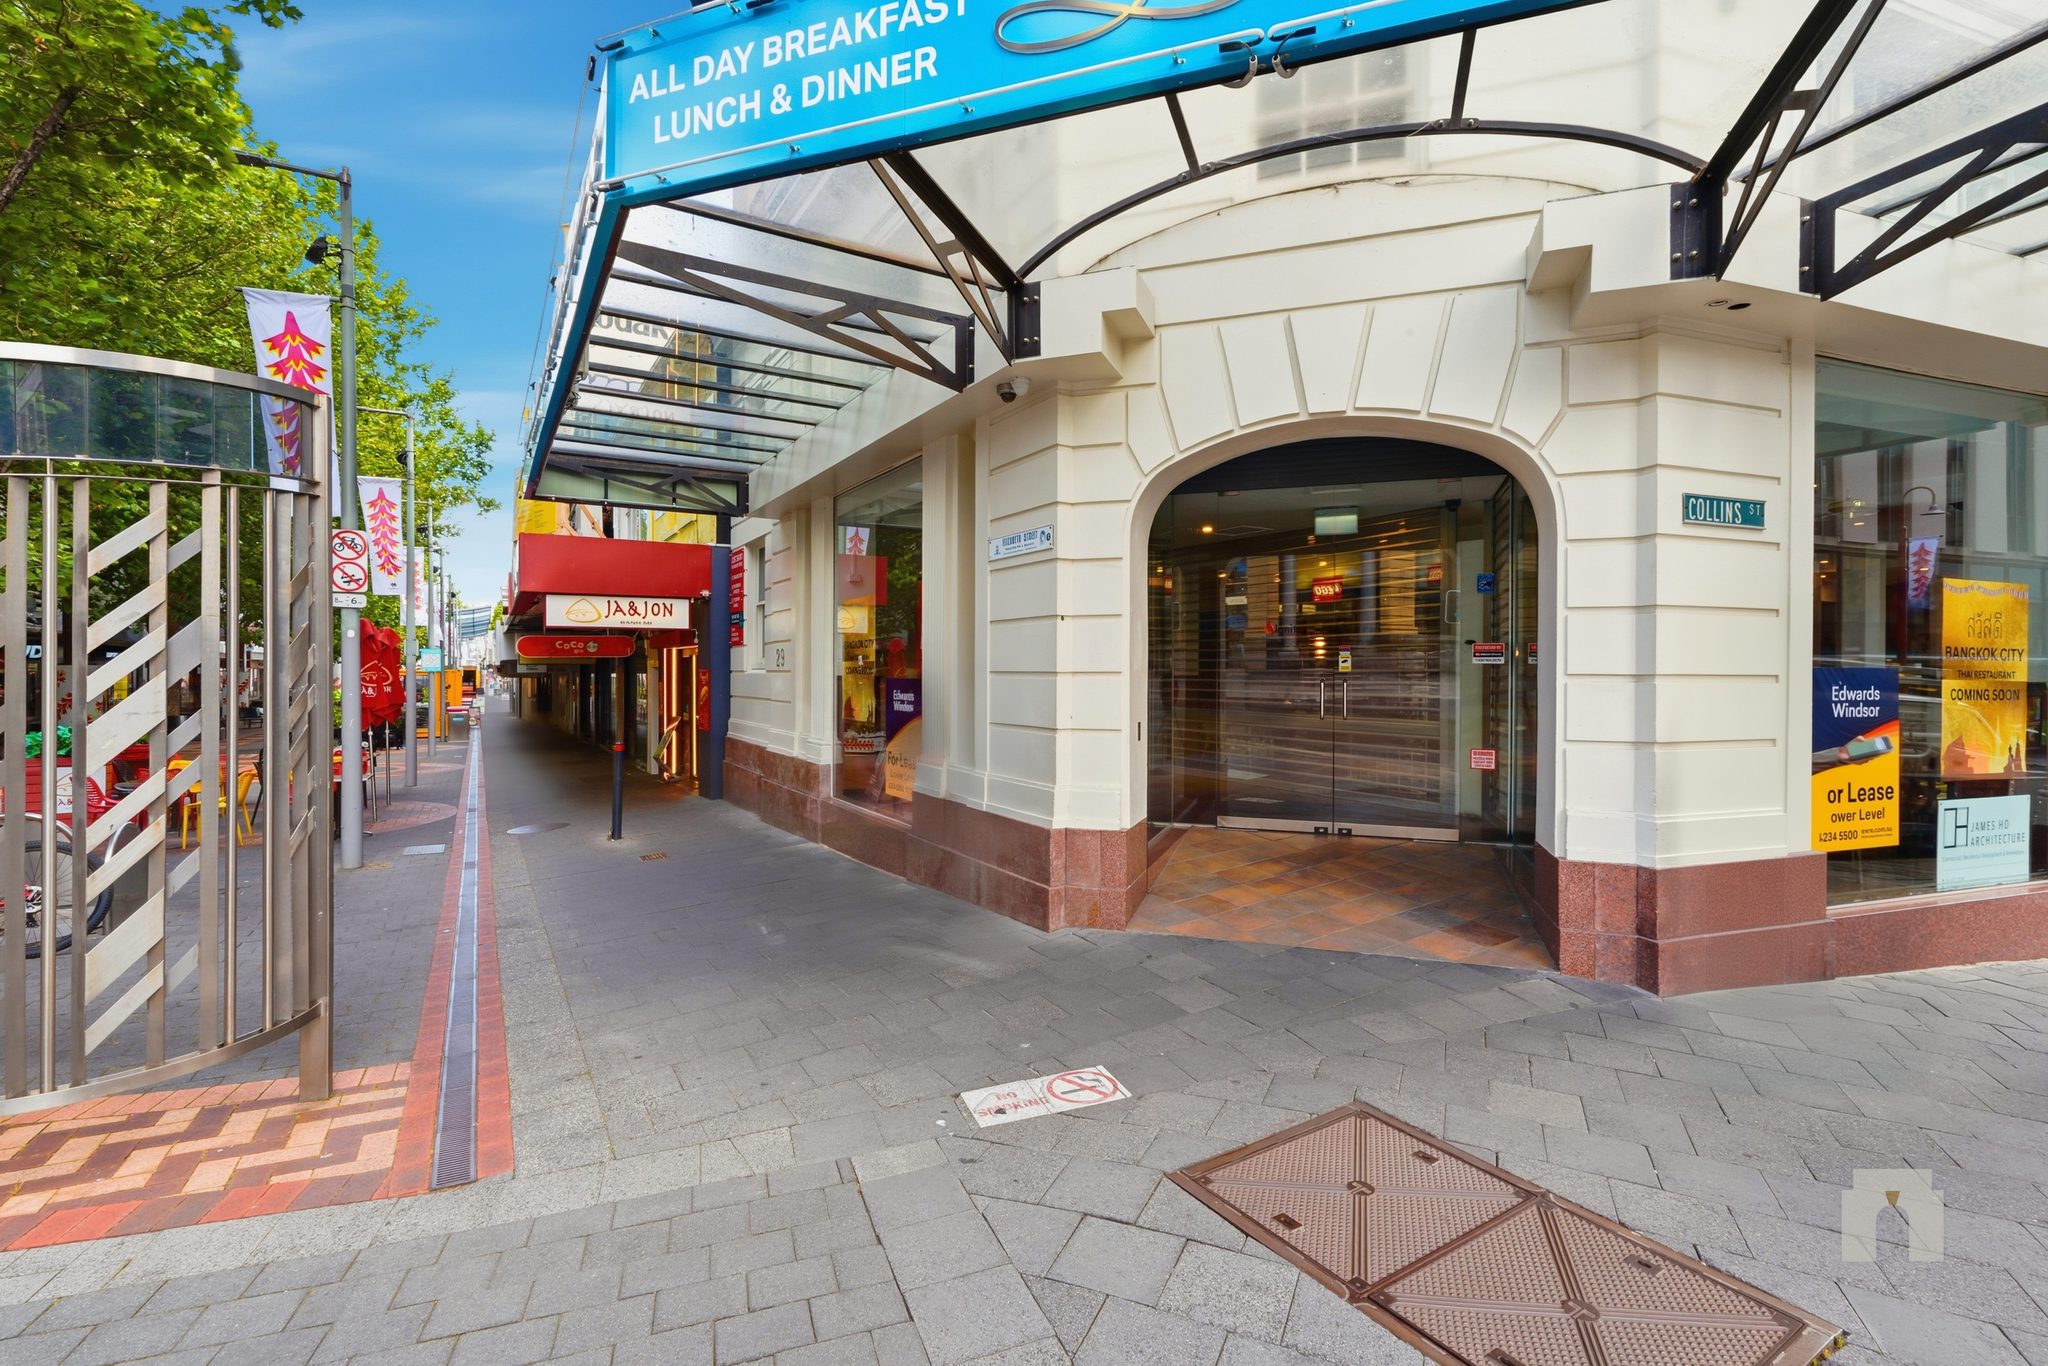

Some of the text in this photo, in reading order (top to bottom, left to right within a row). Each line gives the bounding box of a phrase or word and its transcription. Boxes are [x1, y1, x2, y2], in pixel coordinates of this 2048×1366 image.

[629, 0, 966, 104] ALL DAY BREAKFAST
[654, 46, 938, 144] LUNCH & DINNER
[1688, 498, 1760, 524] COLLINS ST
[605, 600, 673, 619] JA&JON
[776, 648, 784, 667] 29
[1945, 646, 2024, 661] BANGKOK CITY
[1957, 670, 2016, 679] THAI RESTAURANT
[1832, 685, 1880, 700] Edwards
[1950, 688, 2020, 701] COMING SOON
[1832, 703, 1880, 718] Windsor
[1827, 782, 1894, 803] or Lease
[1859, 807, 1885, 820] Level
[1971, 819, 2009, 832] JAMES HO
[1839, 830, 1858, 841] 5500
[1970, 832, 2025, 847] ARCHITECTURE
[994, 1091, 1018, 1101] NO
